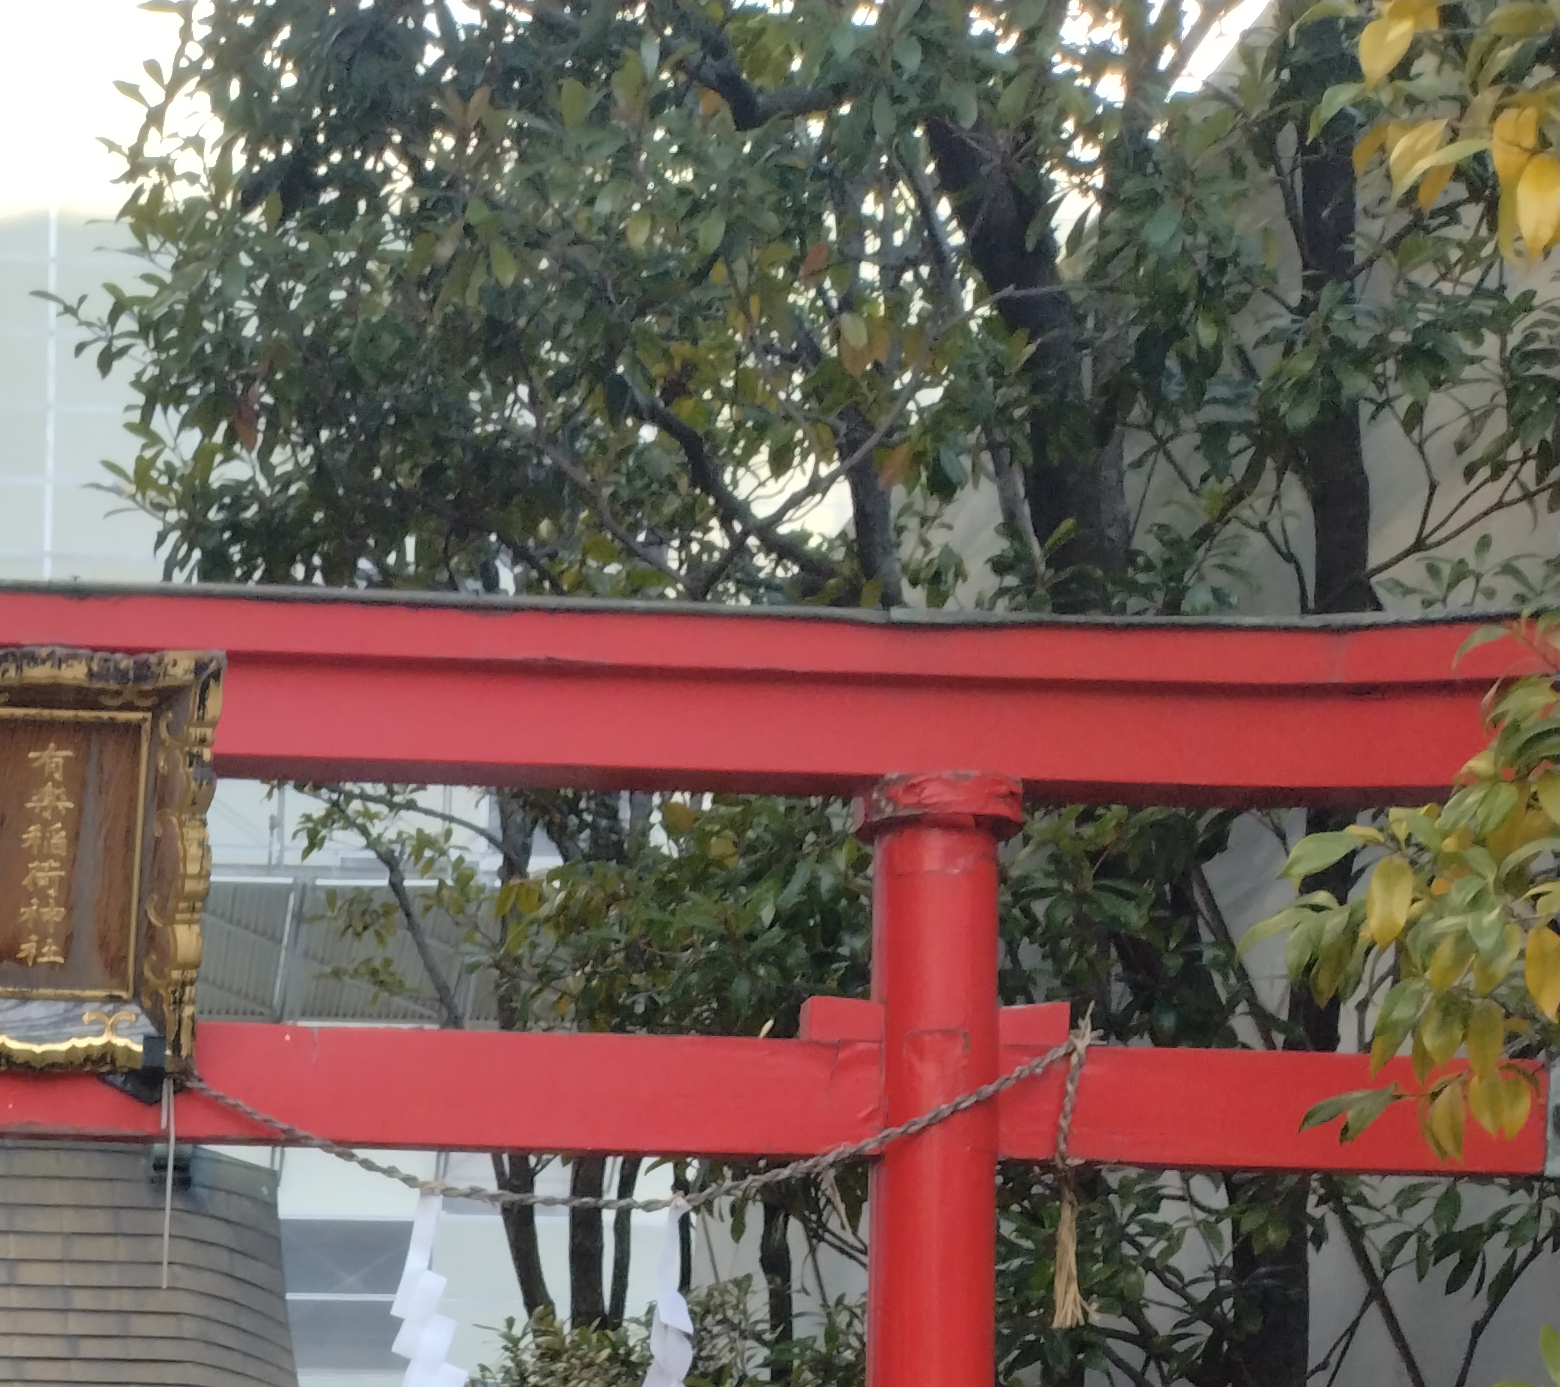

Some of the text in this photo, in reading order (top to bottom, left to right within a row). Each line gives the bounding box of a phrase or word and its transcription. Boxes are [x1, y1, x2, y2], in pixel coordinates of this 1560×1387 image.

[16, 742, 75, 966] 有楽稲荷神社
